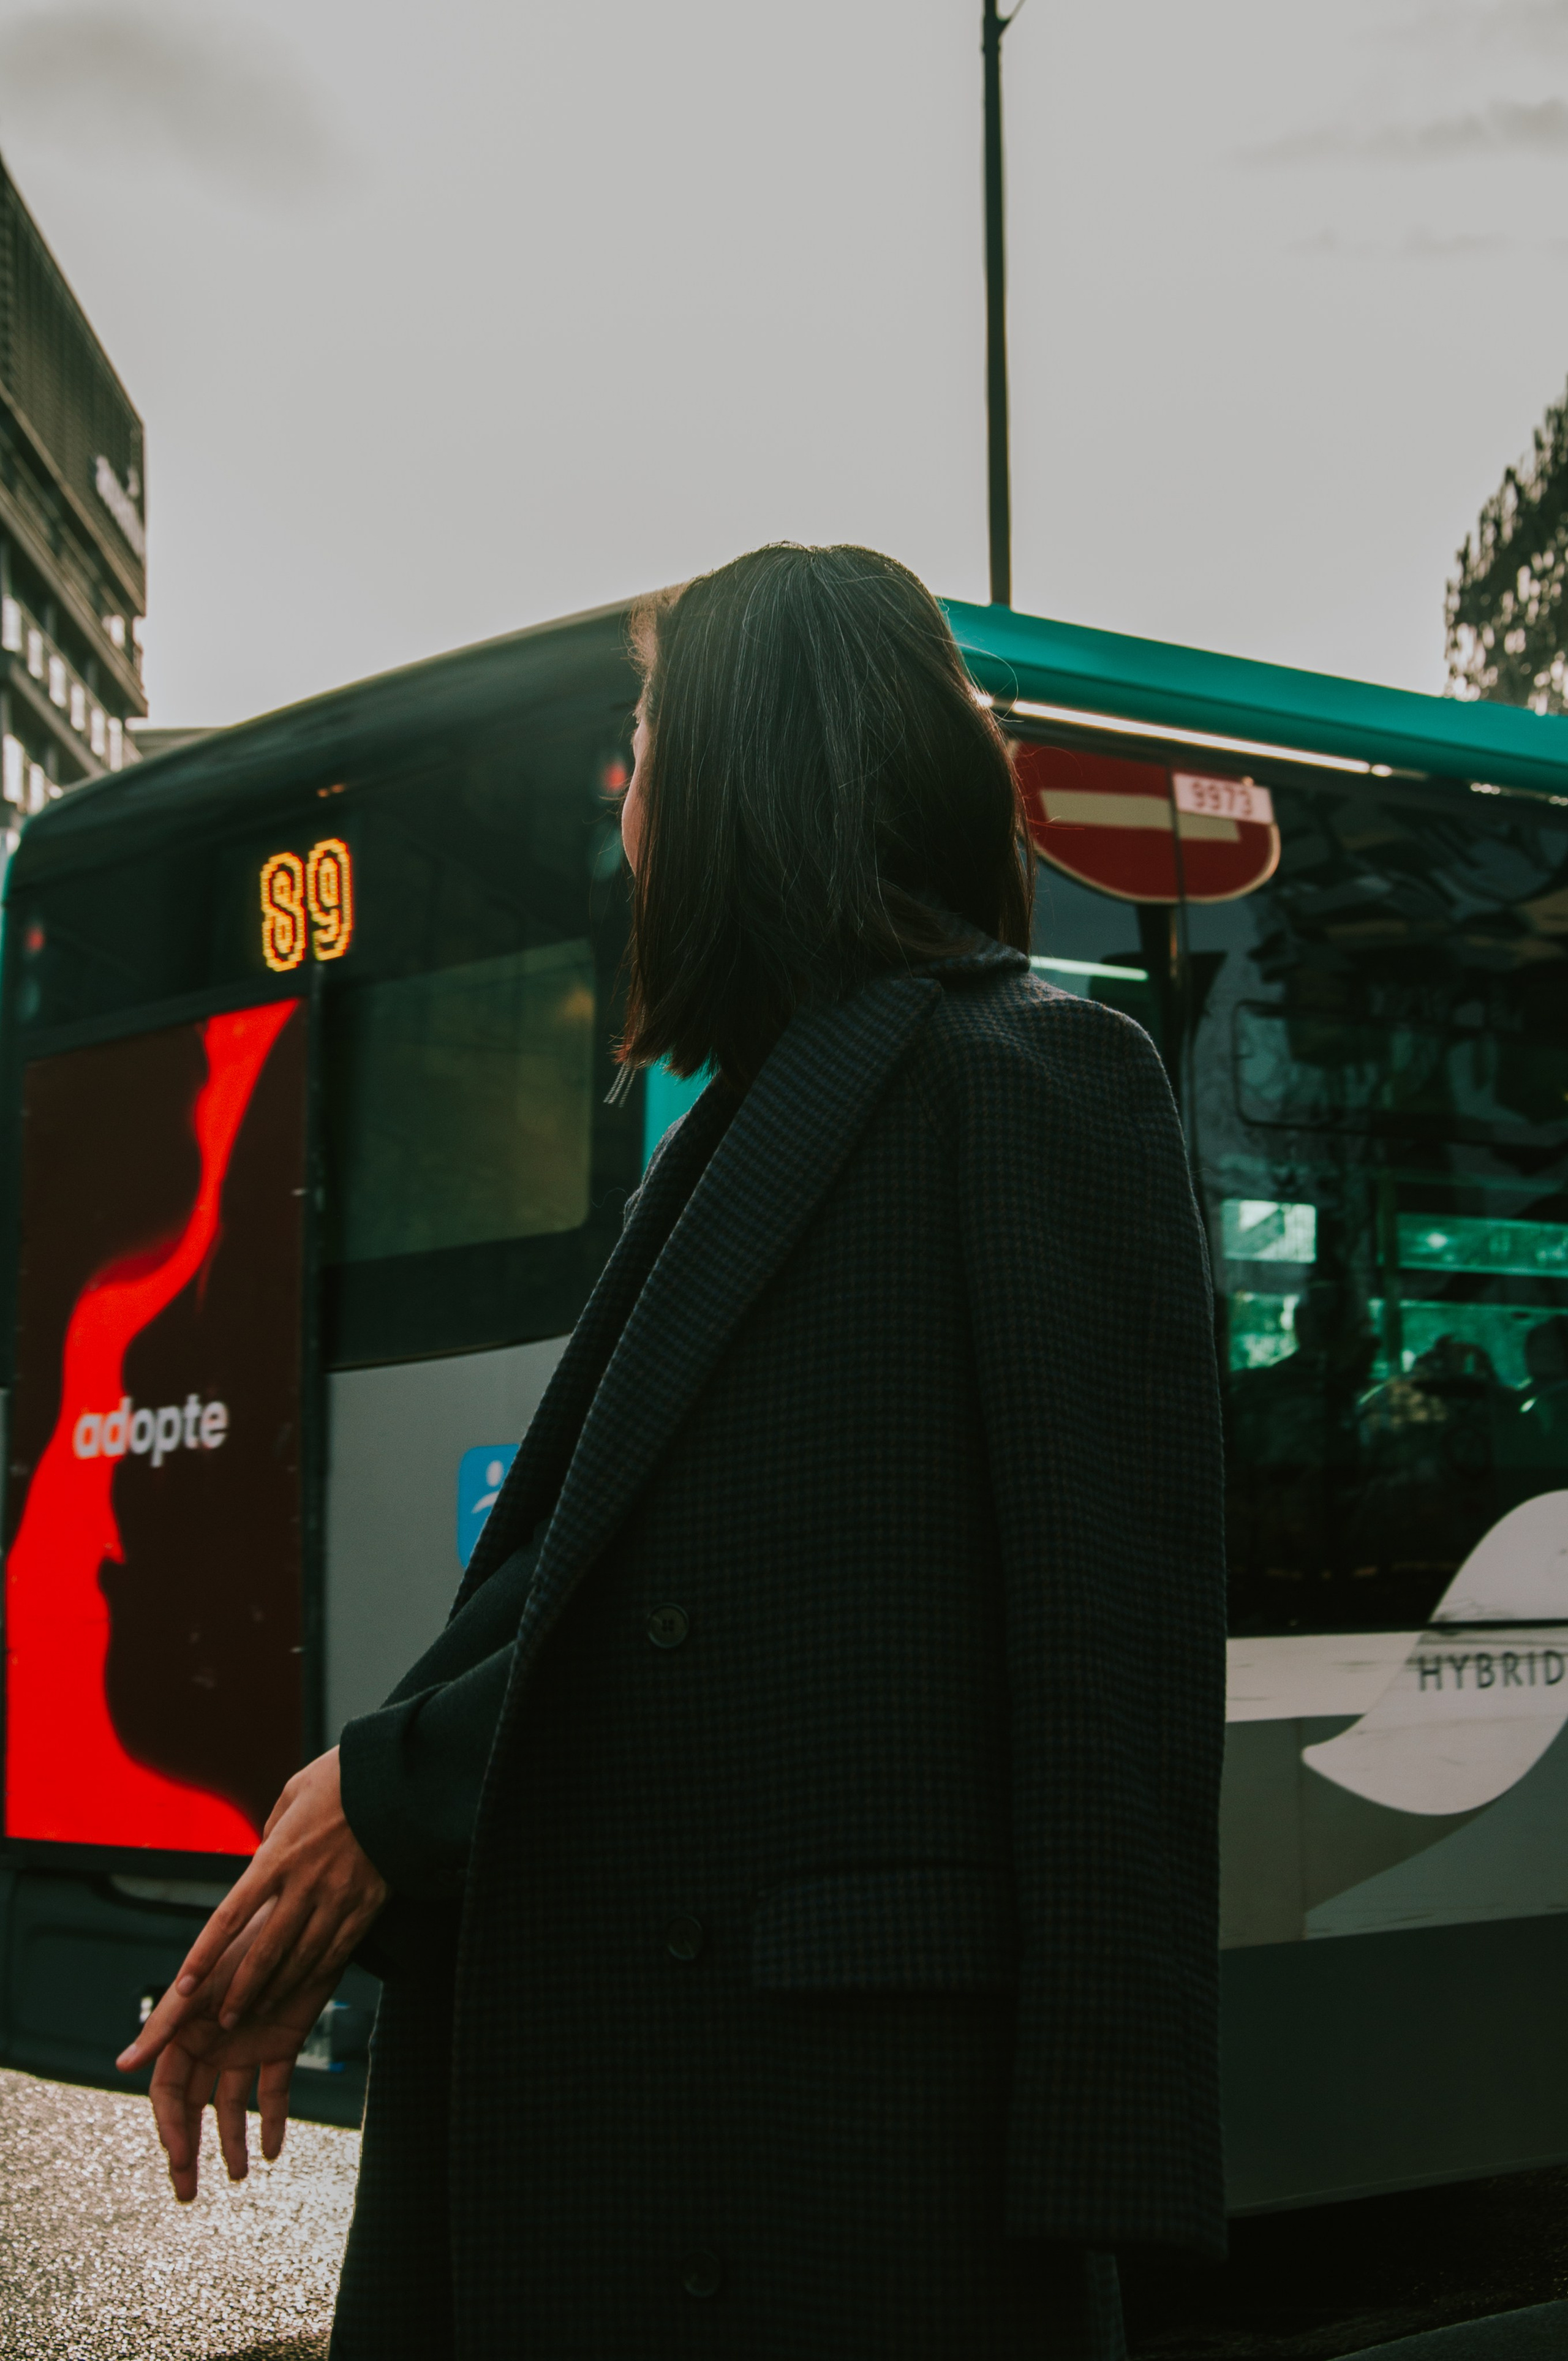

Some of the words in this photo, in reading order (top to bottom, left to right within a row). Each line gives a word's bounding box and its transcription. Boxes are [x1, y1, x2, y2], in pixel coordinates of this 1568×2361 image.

[1191, 781, 1253, 816] 9973
[260, 837, 353, 973] 89
[72, 1393, 229, 1469] adopte
[1417, 1649, 1566, 1692] HYBRID
